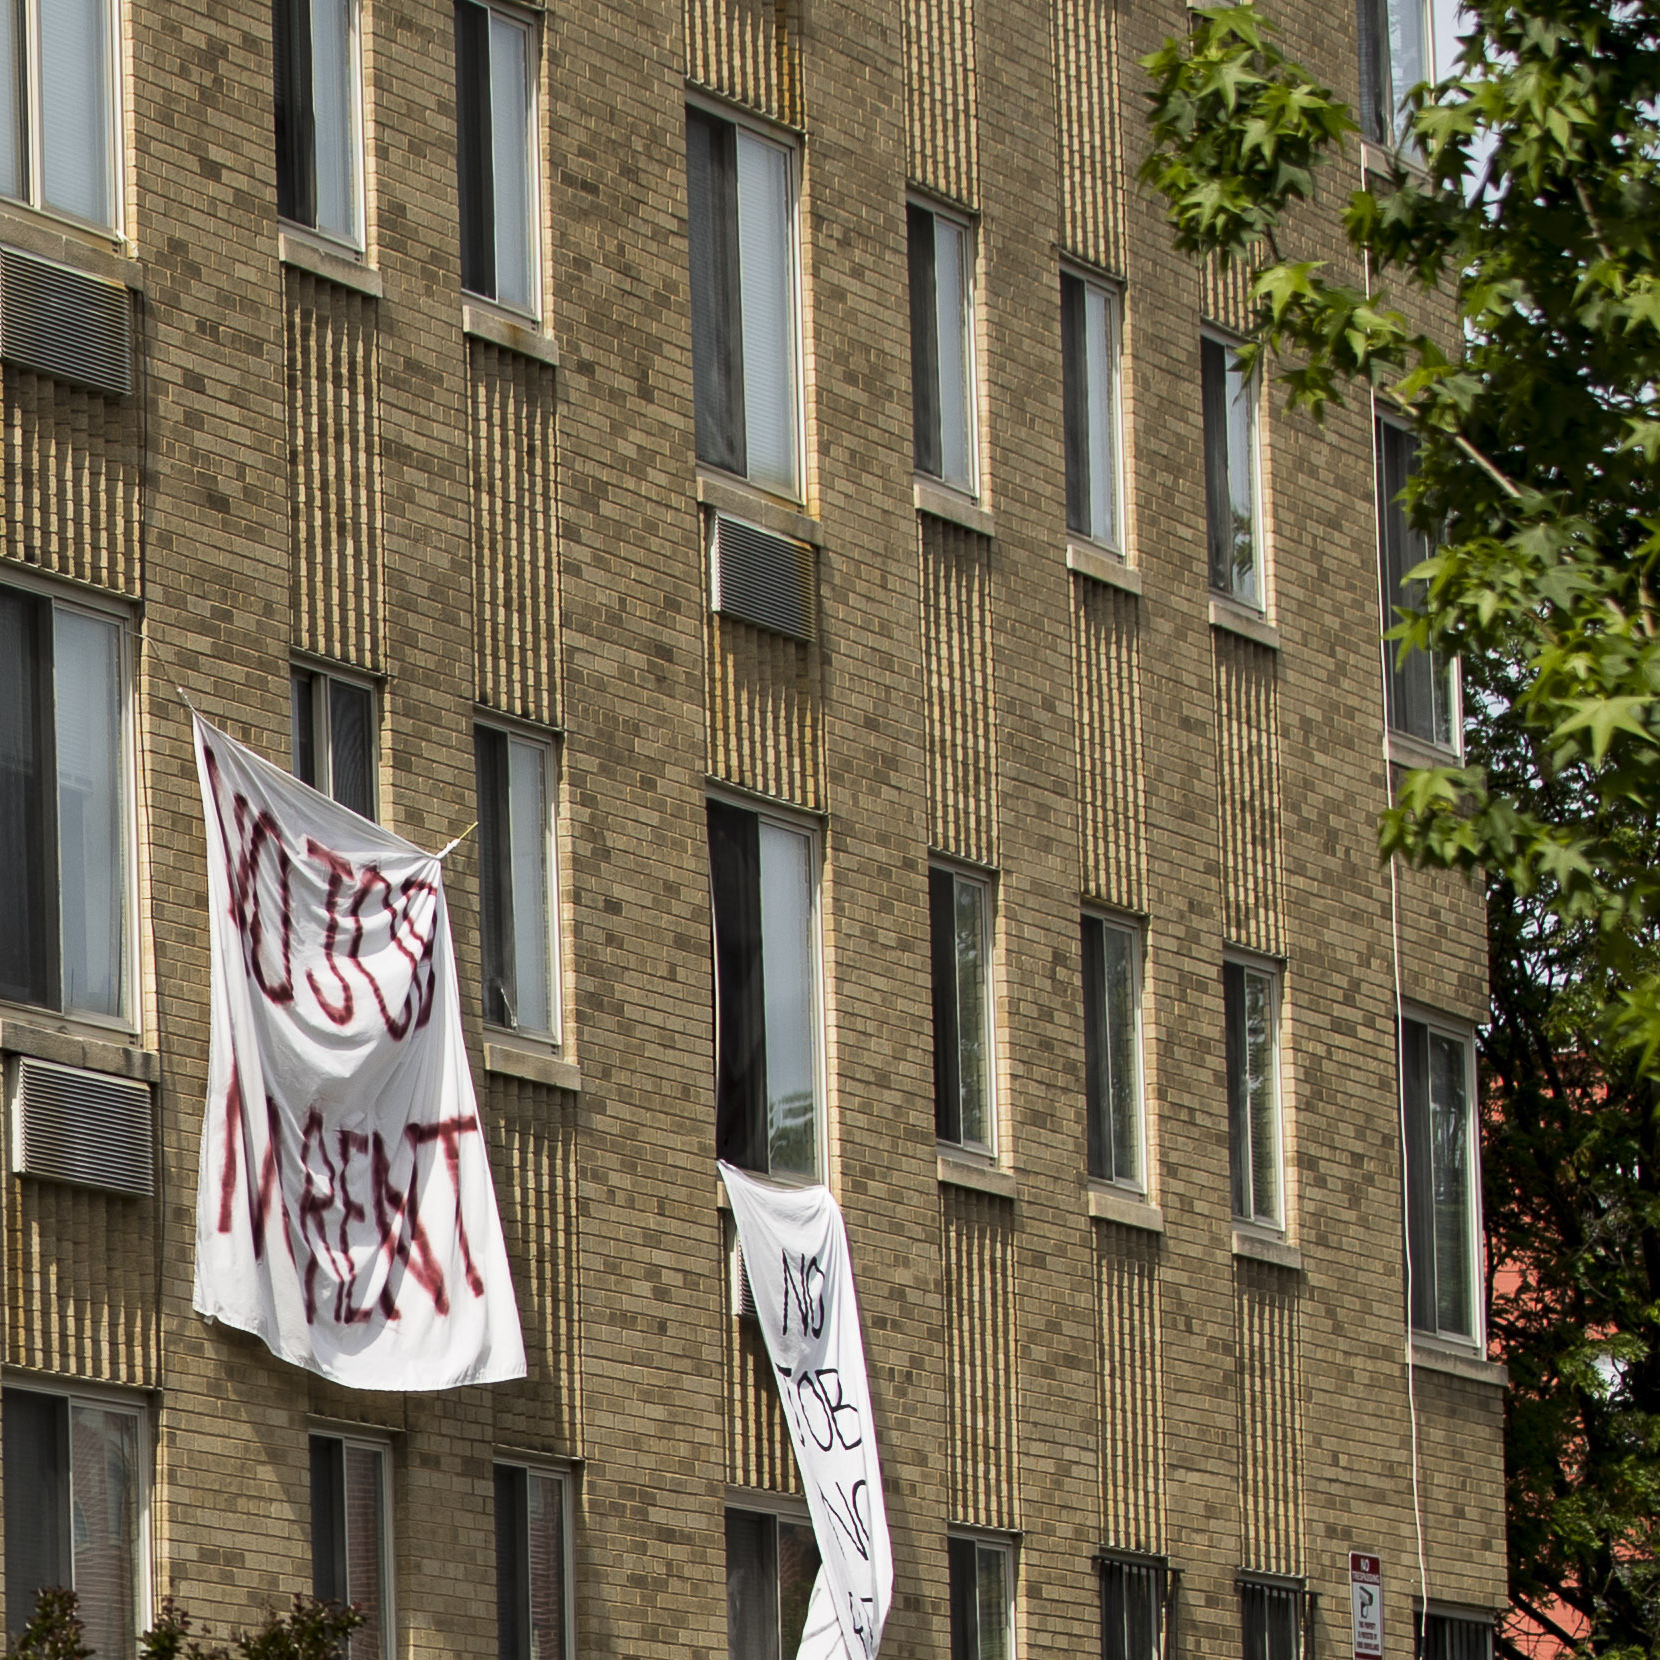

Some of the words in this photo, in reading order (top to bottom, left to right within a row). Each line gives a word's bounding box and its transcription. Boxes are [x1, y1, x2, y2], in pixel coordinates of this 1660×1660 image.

[203, 745, 295, 1006] NO
[299, 1102, 484, 1326] RENT
[780, 1247, 826, 1340] NO
